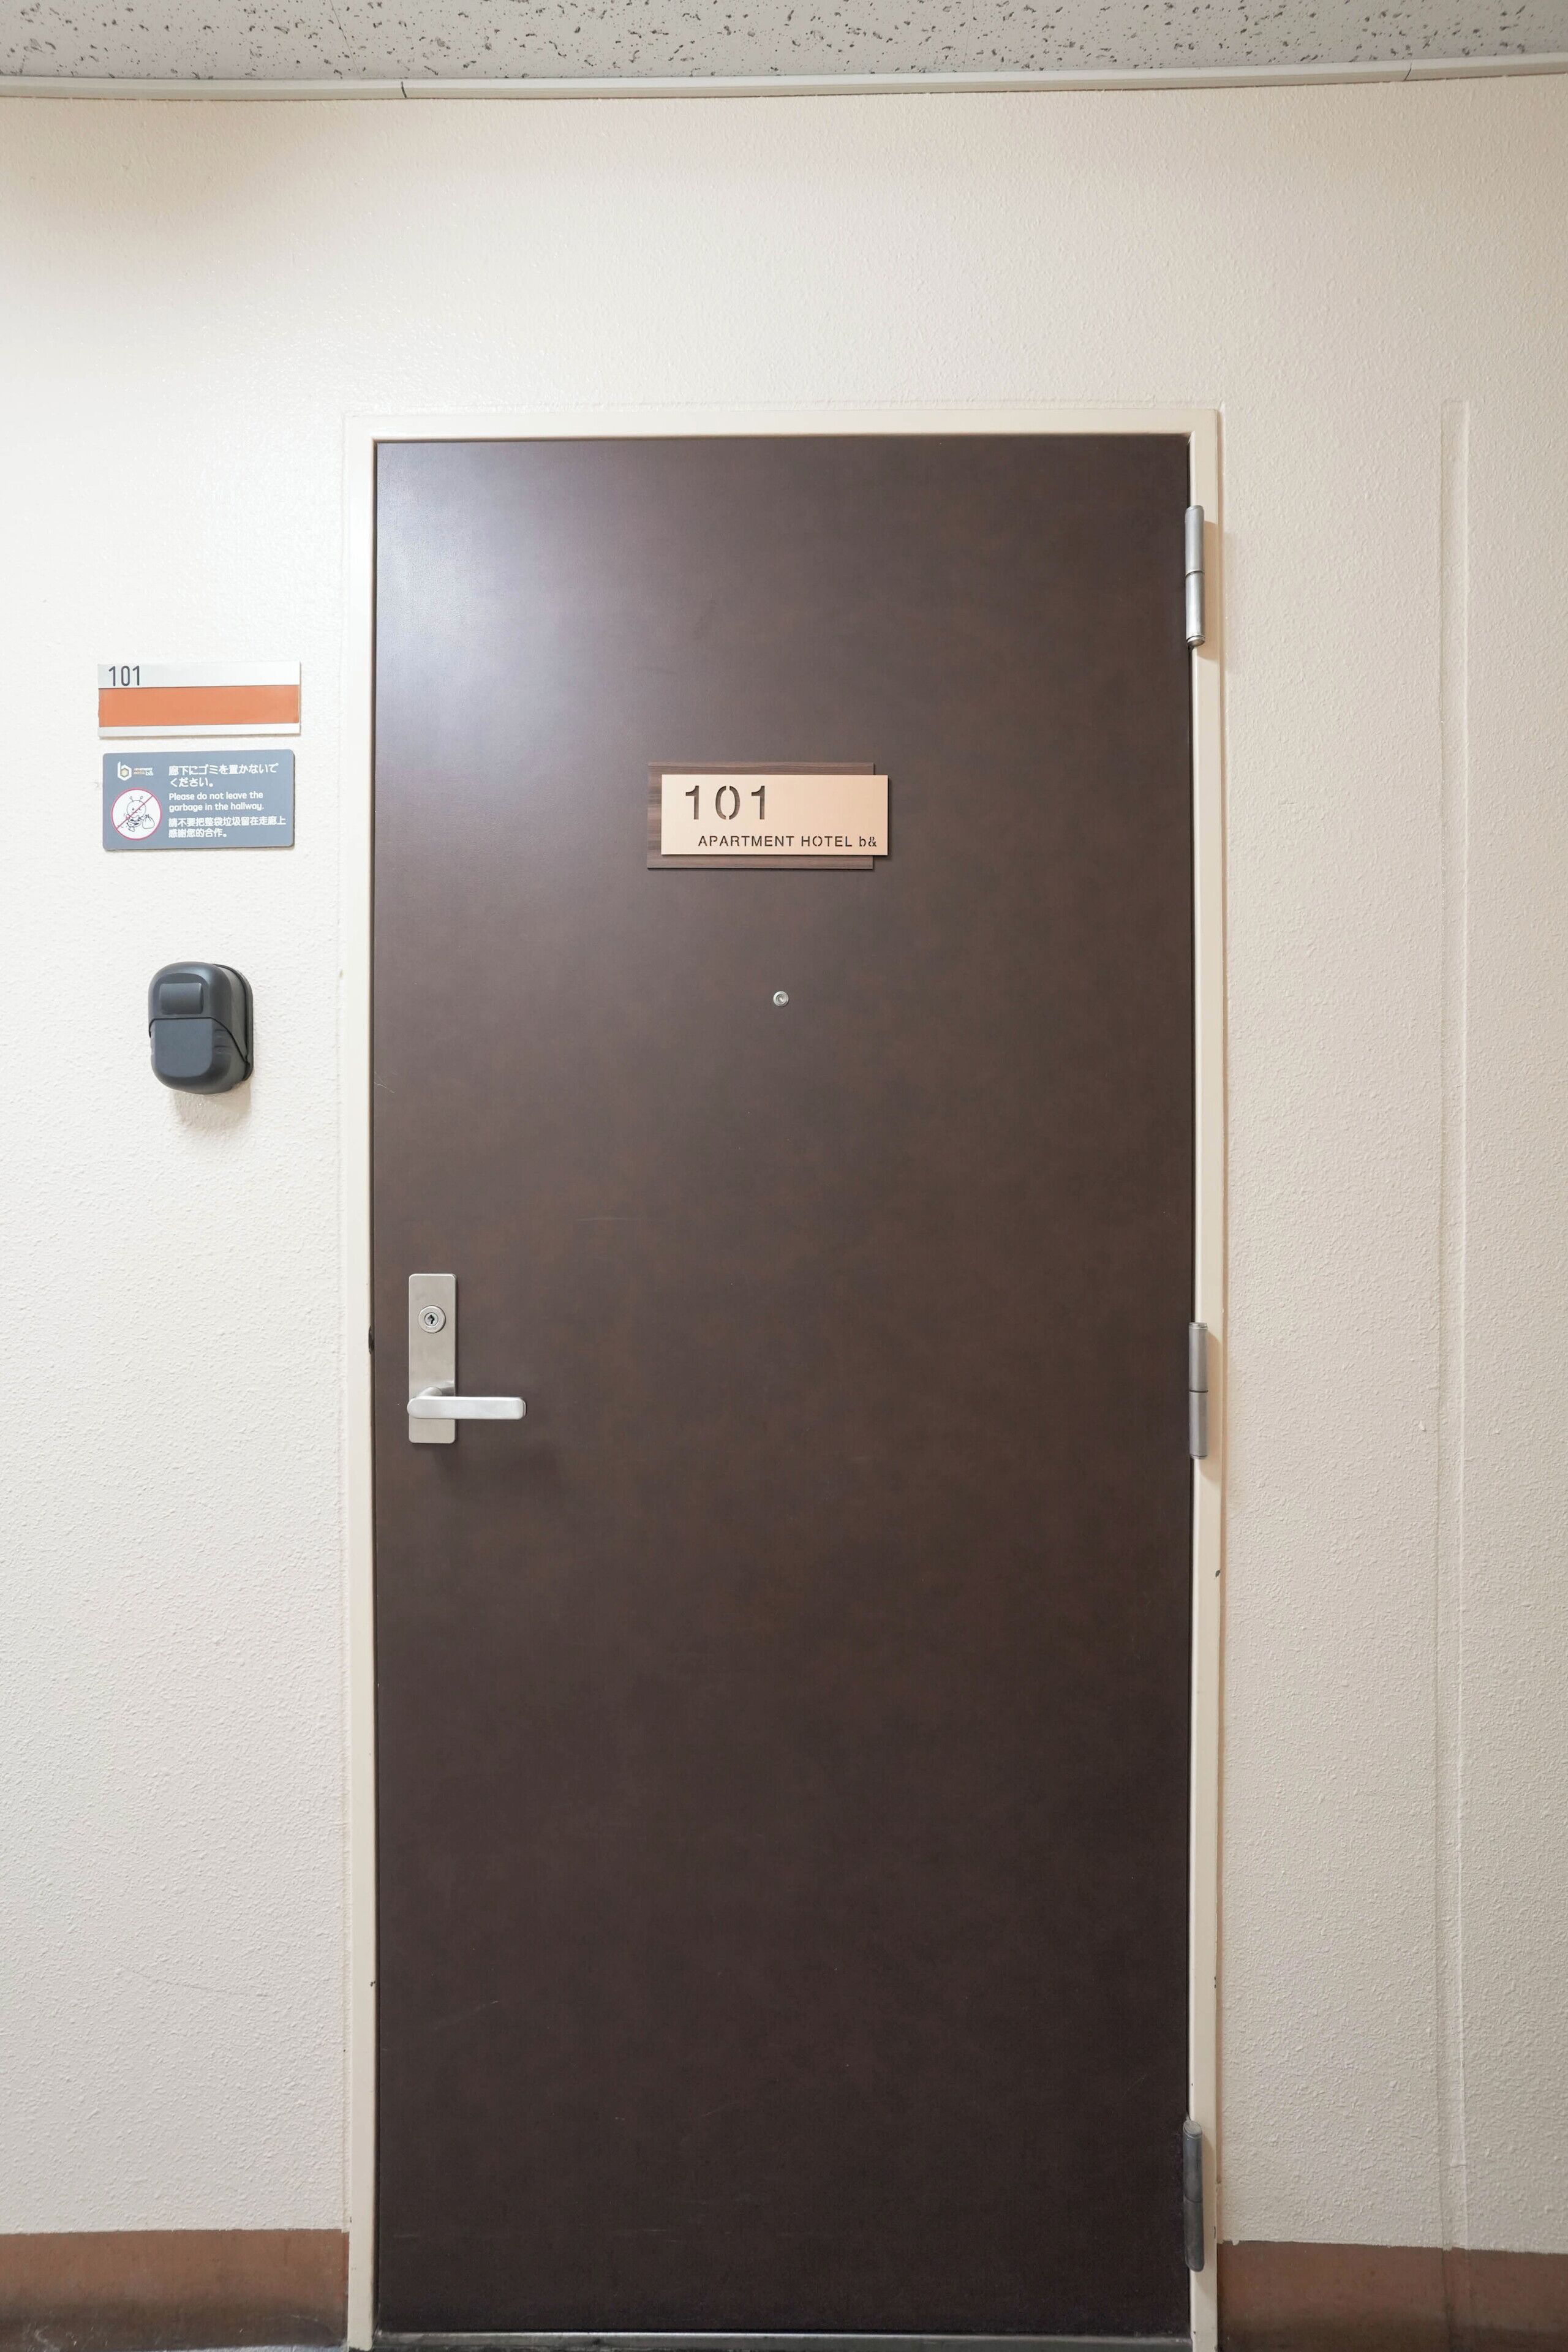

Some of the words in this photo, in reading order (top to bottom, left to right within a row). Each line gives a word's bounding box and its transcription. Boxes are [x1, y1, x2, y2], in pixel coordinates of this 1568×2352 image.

[108, 665, 140, 687] 101
[168, 763, 279, 776] 廊下にゴミを置かないで
[170, 777, 213, 788] ください。
[168, 803, 203, 813] garbage
[230, 802, 265, 811] hallway.
[685, 785, 765, 821] 101
[698, 835, 794, 846] APARTMENT
[801, 835, 852, 847] HOTEL
[859, 836, 877, 847] b&
